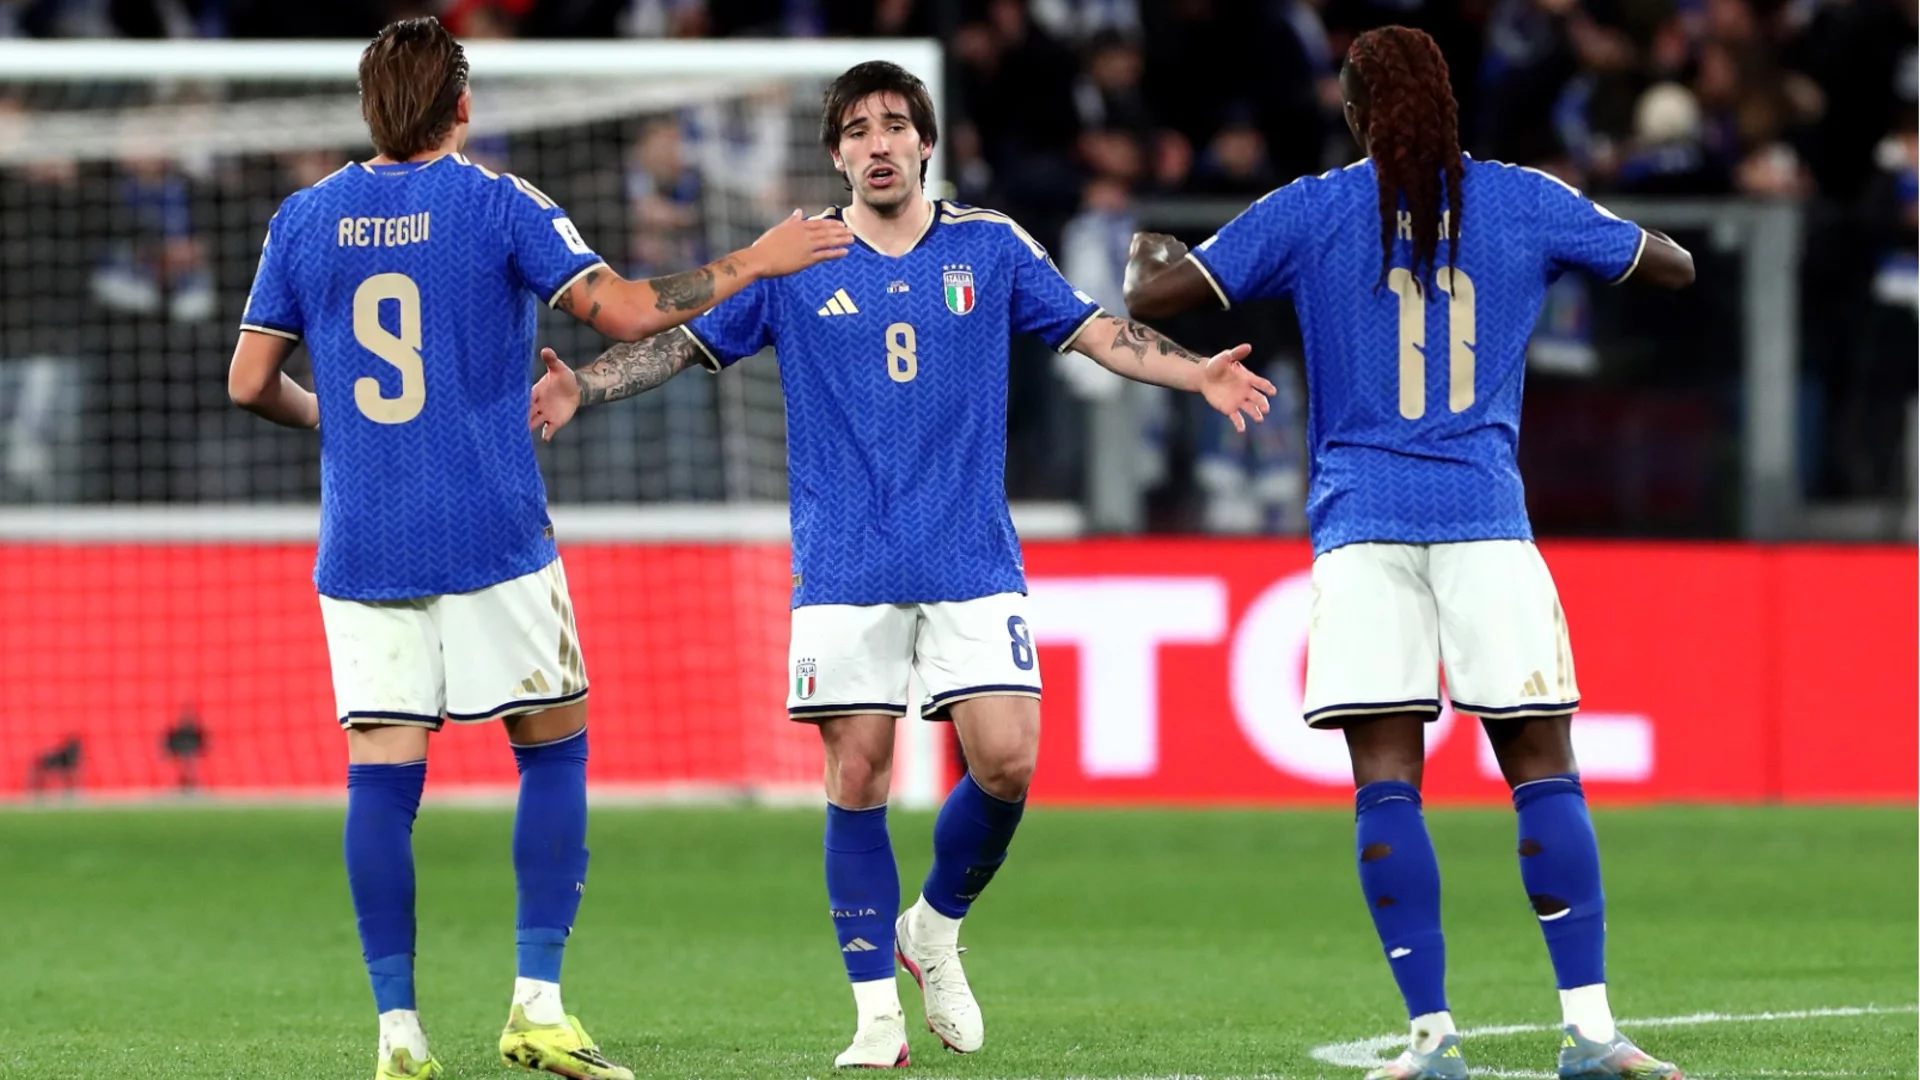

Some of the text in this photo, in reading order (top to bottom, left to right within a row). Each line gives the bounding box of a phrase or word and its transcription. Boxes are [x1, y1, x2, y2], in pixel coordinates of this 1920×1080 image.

[338, 212, 430, 247] RETEGUI
[946, 274, 971, 283] ITALIA
[353, 272, 426, 424] 9
[885, 322, 918, 383] 8
[1388, 265, 1476, 420] 11
[1007, 615, 1034, 671] 8
[829, 908, 877, 918] TALIA
